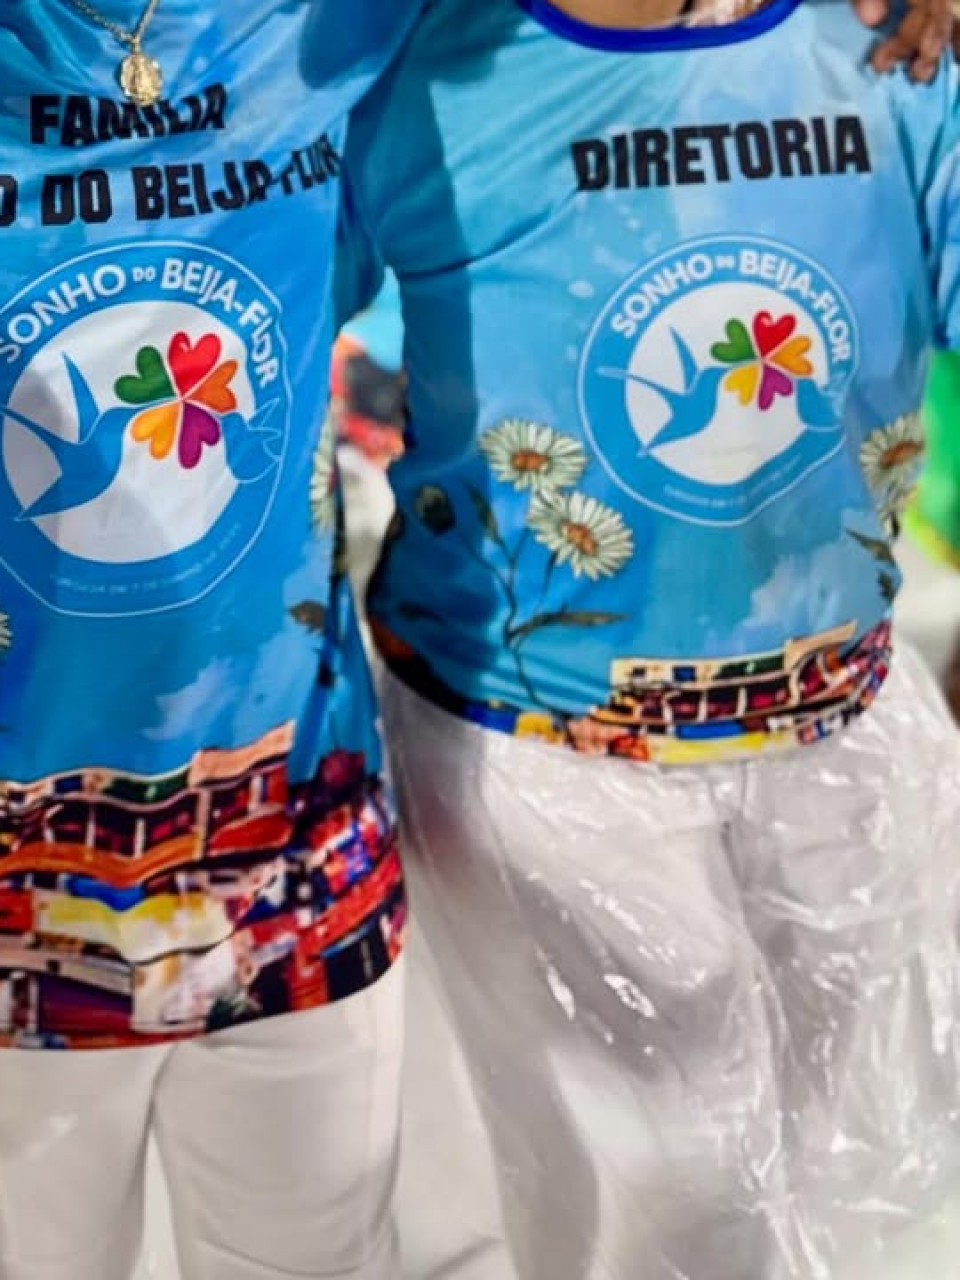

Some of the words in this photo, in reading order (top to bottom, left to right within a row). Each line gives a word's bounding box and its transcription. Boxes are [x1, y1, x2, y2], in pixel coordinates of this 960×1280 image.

[41, 170, 113, 226] DO
[571, 115, 872, 192] DIRETORIA
[132, 266, 156, 282] DO
[161, 258, 279, 387] BEIJA-FLOR
[612, 254, 714, 339] SONHO
[740, 251, 851, 364] BEIJA-FLOR
